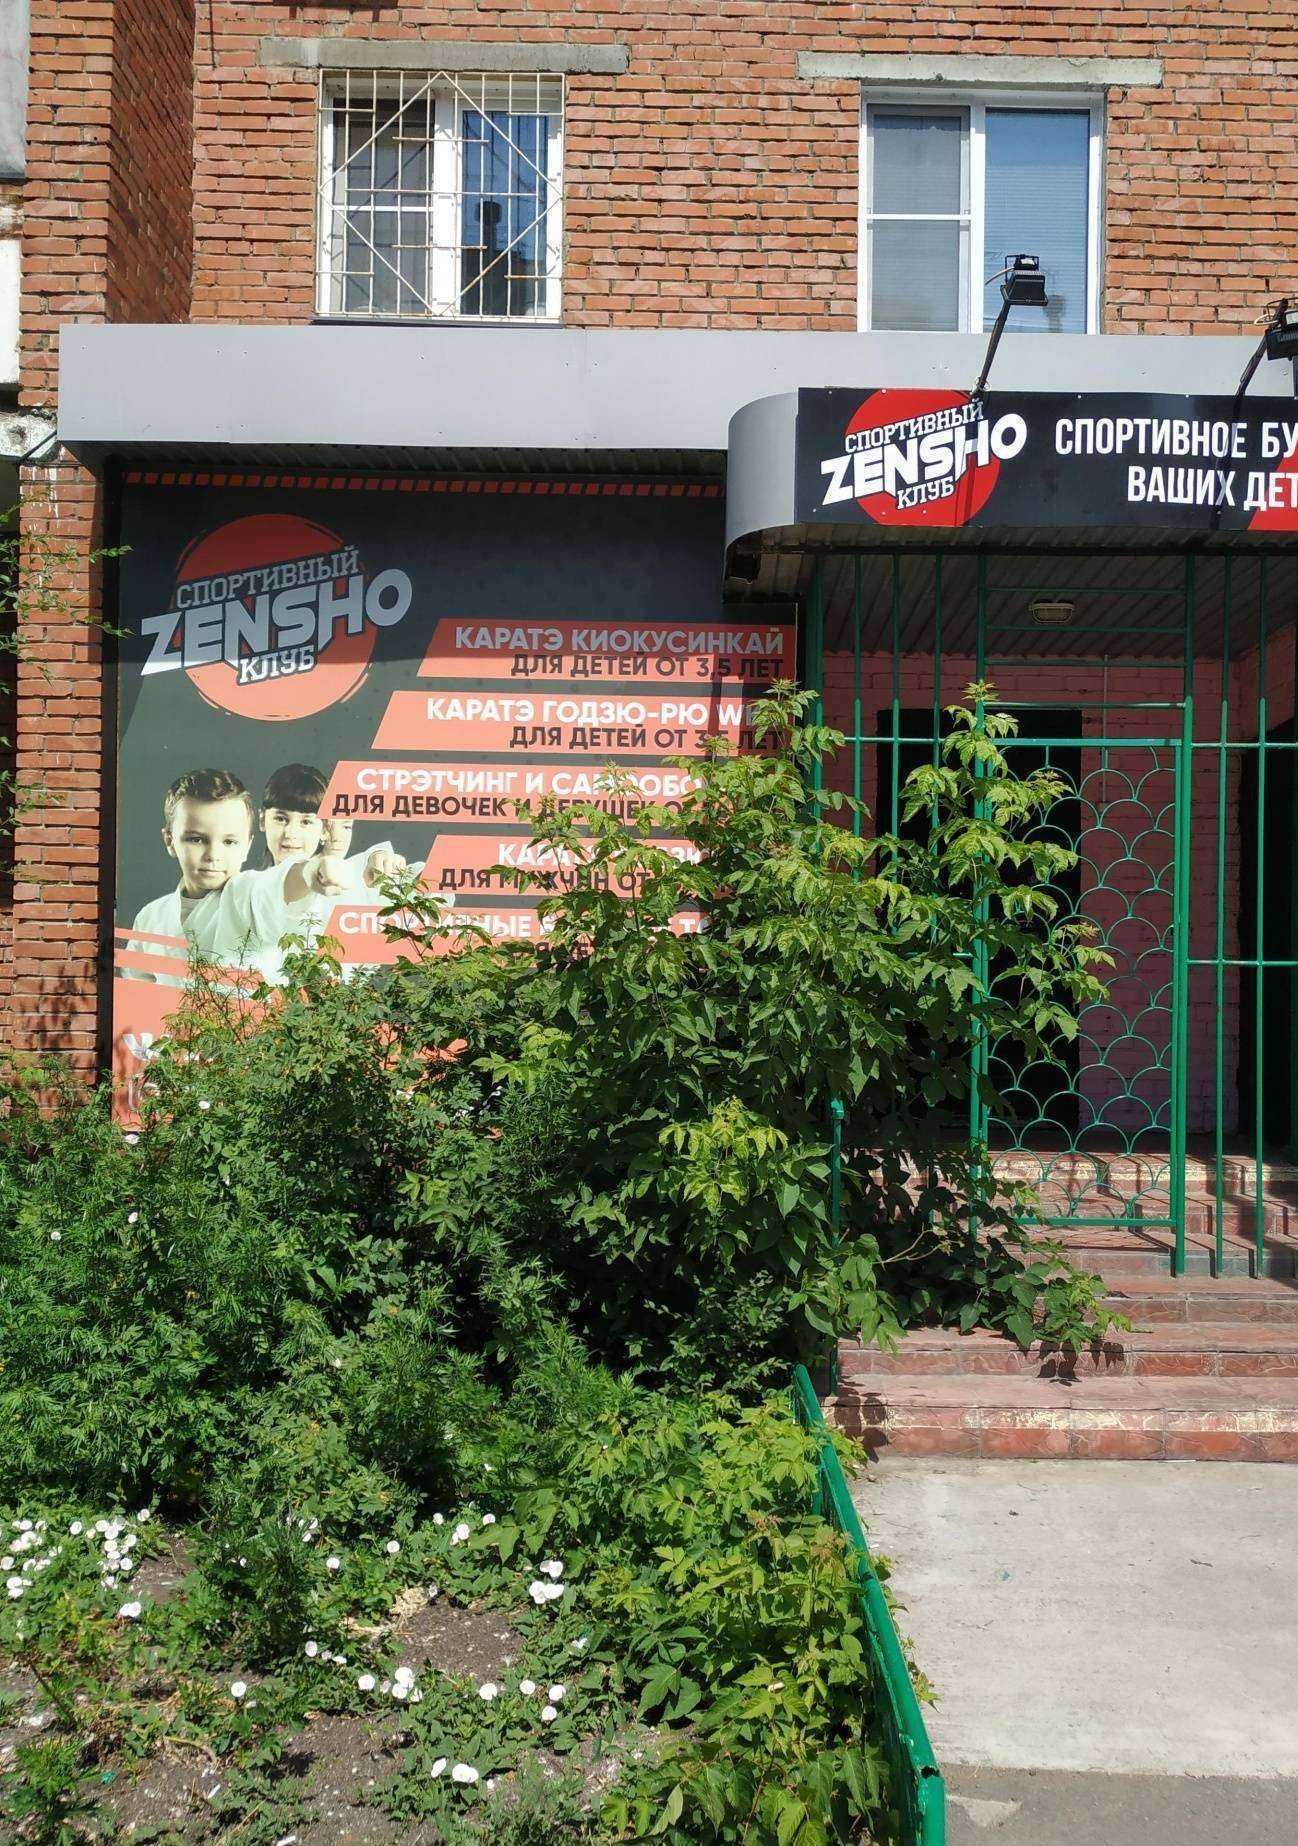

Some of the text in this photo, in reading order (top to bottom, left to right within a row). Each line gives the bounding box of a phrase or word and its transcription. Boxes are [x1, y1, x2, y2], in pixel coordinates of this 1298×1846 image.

[844, 398, 984, 452] СПОРТИВНЫЙ
[1054, 418, 1247, 458] СПОРТИВНОЕ
[820, 413, 1028, 506] ZENSHO
[897, 475, 955, 510] КЛУБ
[1127, 465, 1236, 507] ВАШИХ
[175, 546, 359, 609] СПОРТИВНЫЙ
[140, 568, 413, 676] ZENSHO
[454, 626, 784, 655] КАРАТЭ КИОКУСИНКАЙ
[238, 645, 317, 684] КЛУБ
[510, 651, 784, 681] ДЛЯ ДЕТЕЙ ОТ 3,5 ЛЕТ
[426, 698, 535, 722] КАРАТЭ
[542, 700, 710, 728] ГОДЗЮ-РЮ
[509, 726, 562, 749] ДЛЯ
[568, 723, 647, 751] ДЕТЕЙ
[654, 728, 688, 749] ОТ
[355, 768, 519, 793] СТРЭТЧИНГ
[524, 771, 544, 794] И
[331, 793, 385, 817] ДЛЯ
[391, 795, 508, 818] ДЕВОЧЕК
[438, 868, 491, 891] ДЛЯ
[499, 870, 609, 891] МЖЧИН
